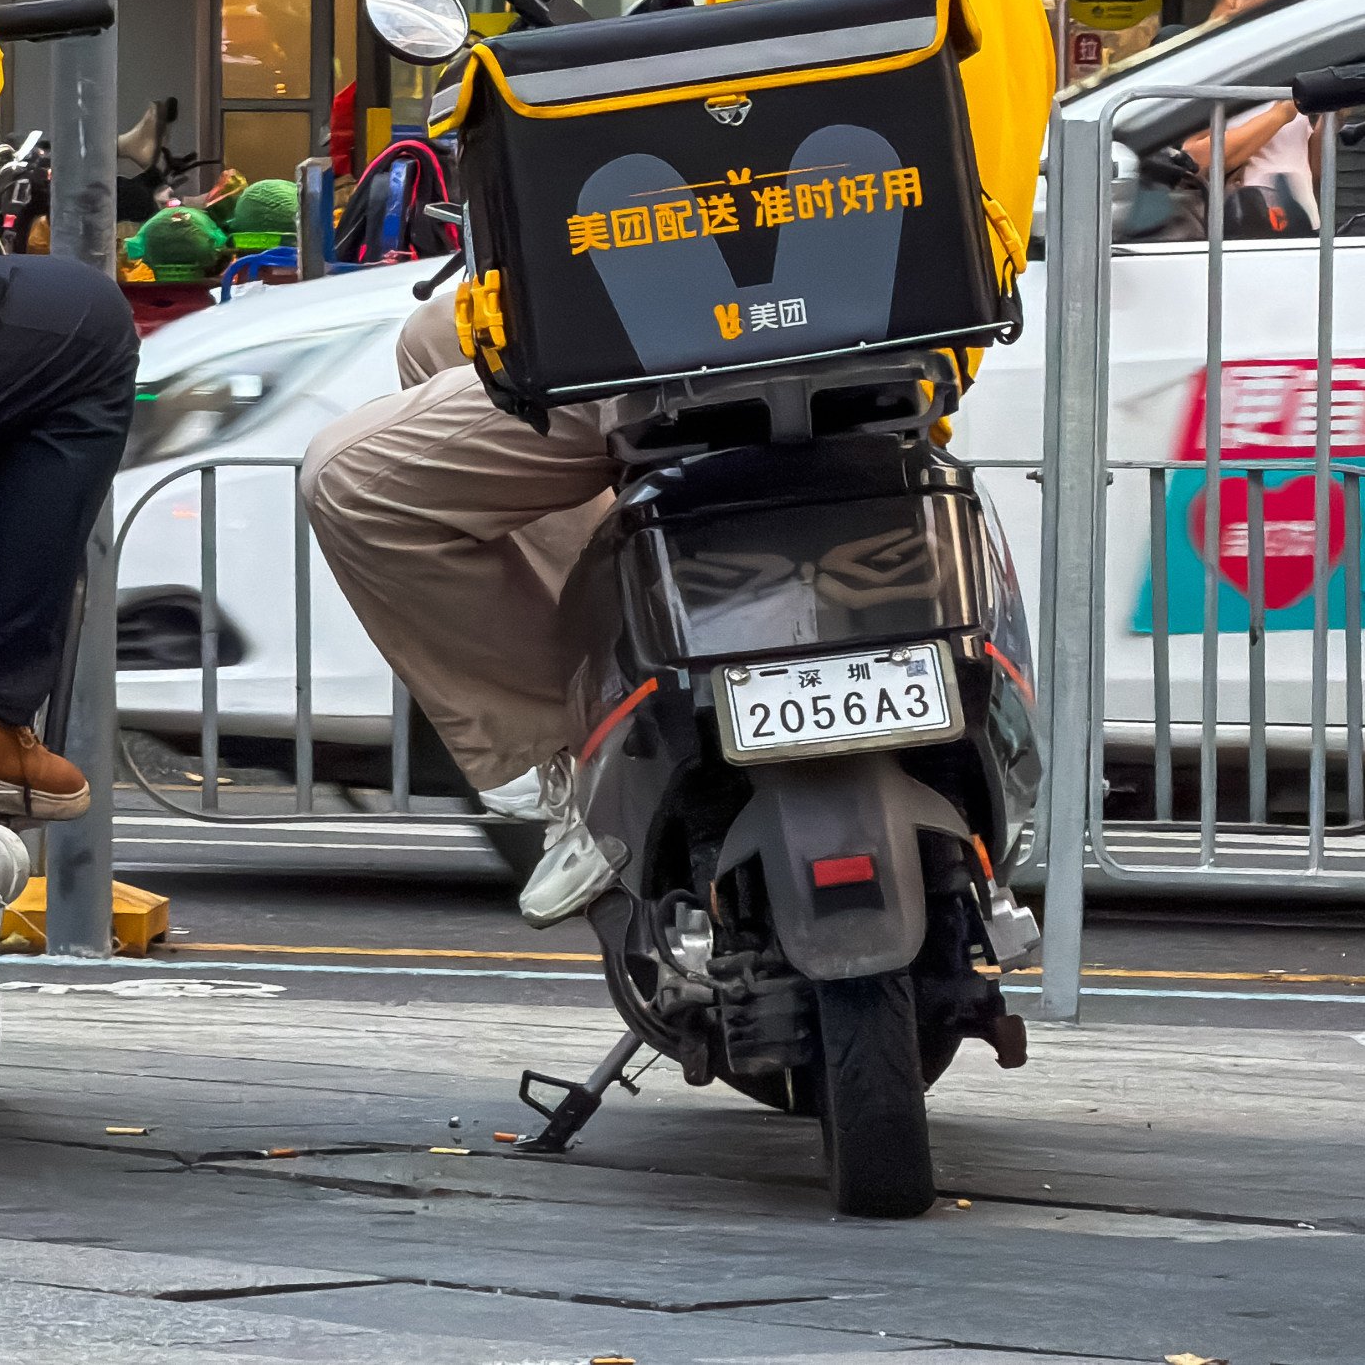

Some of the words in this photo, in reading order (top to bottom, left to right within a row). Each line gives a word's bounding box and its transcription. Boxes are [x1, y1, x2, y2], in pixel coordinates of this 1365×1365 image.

[566, 192, 740, 256] 美团配送
[751, 166, 924, 228] 准时好用
[748, 297, 808, 333] 美团
[798, 662, 872, 689] 深圳
[748, 683, 930, 738] 2056A3
